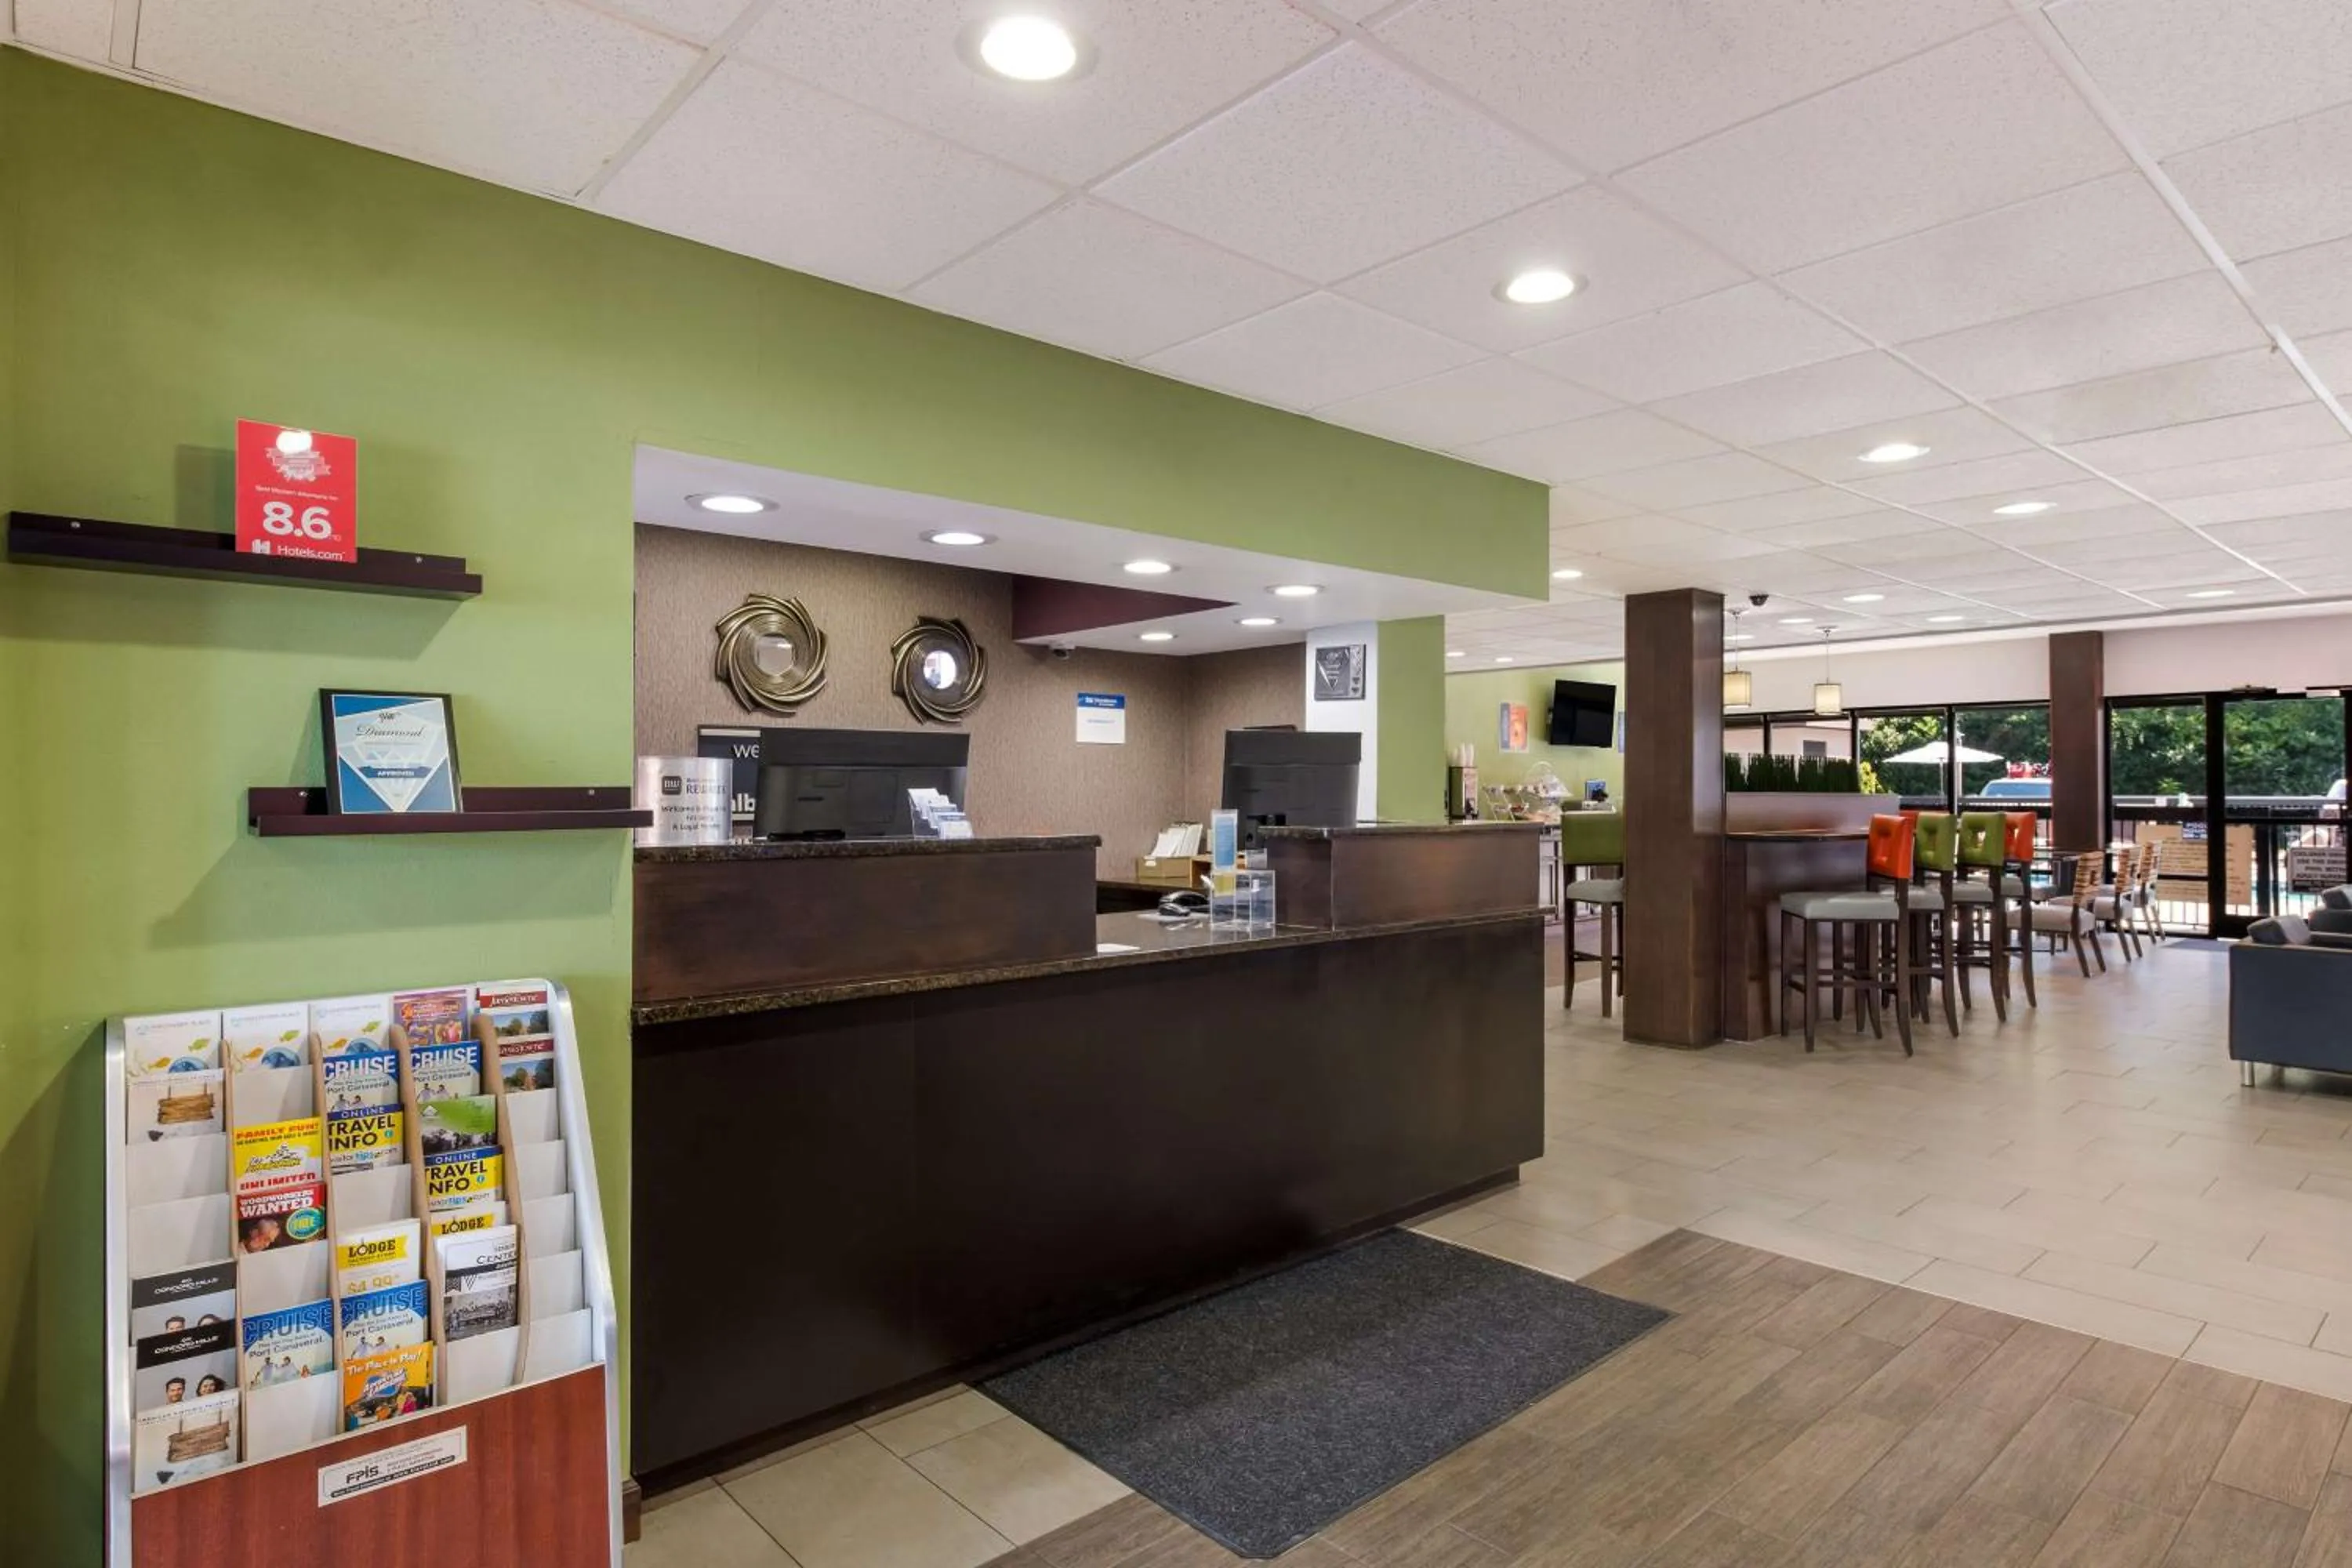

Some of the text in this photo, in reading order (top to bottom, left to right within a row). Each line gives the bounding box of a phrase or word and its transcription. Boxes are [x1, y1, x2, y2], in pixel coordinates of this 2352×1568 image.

[263, 501, 332, 540] 8.6
[278, 545, 343, 561] Hotels.com
[323, 1054, 396, 1081] CRUISE
[410, 1046, 477, 1070] CRUISE
[341, 1106, 385, 1119] ONLINE
[328, 1115, 396, 1136] TRAVEL
[329, 1132, 378, 1152] INFO
[435, 1152, 477, 1164] ONLINE
[429, 1178, 470, 1195] NFO
[240, 1196, 314, 1218] WANTED
[441, 1216, 485, 1235] LODGE
[348, 1239, 396, 1258] LODGE
[340, 1287, 423, 1323] CRUISE
[243, 1304, 332, 1347] CRUISE
